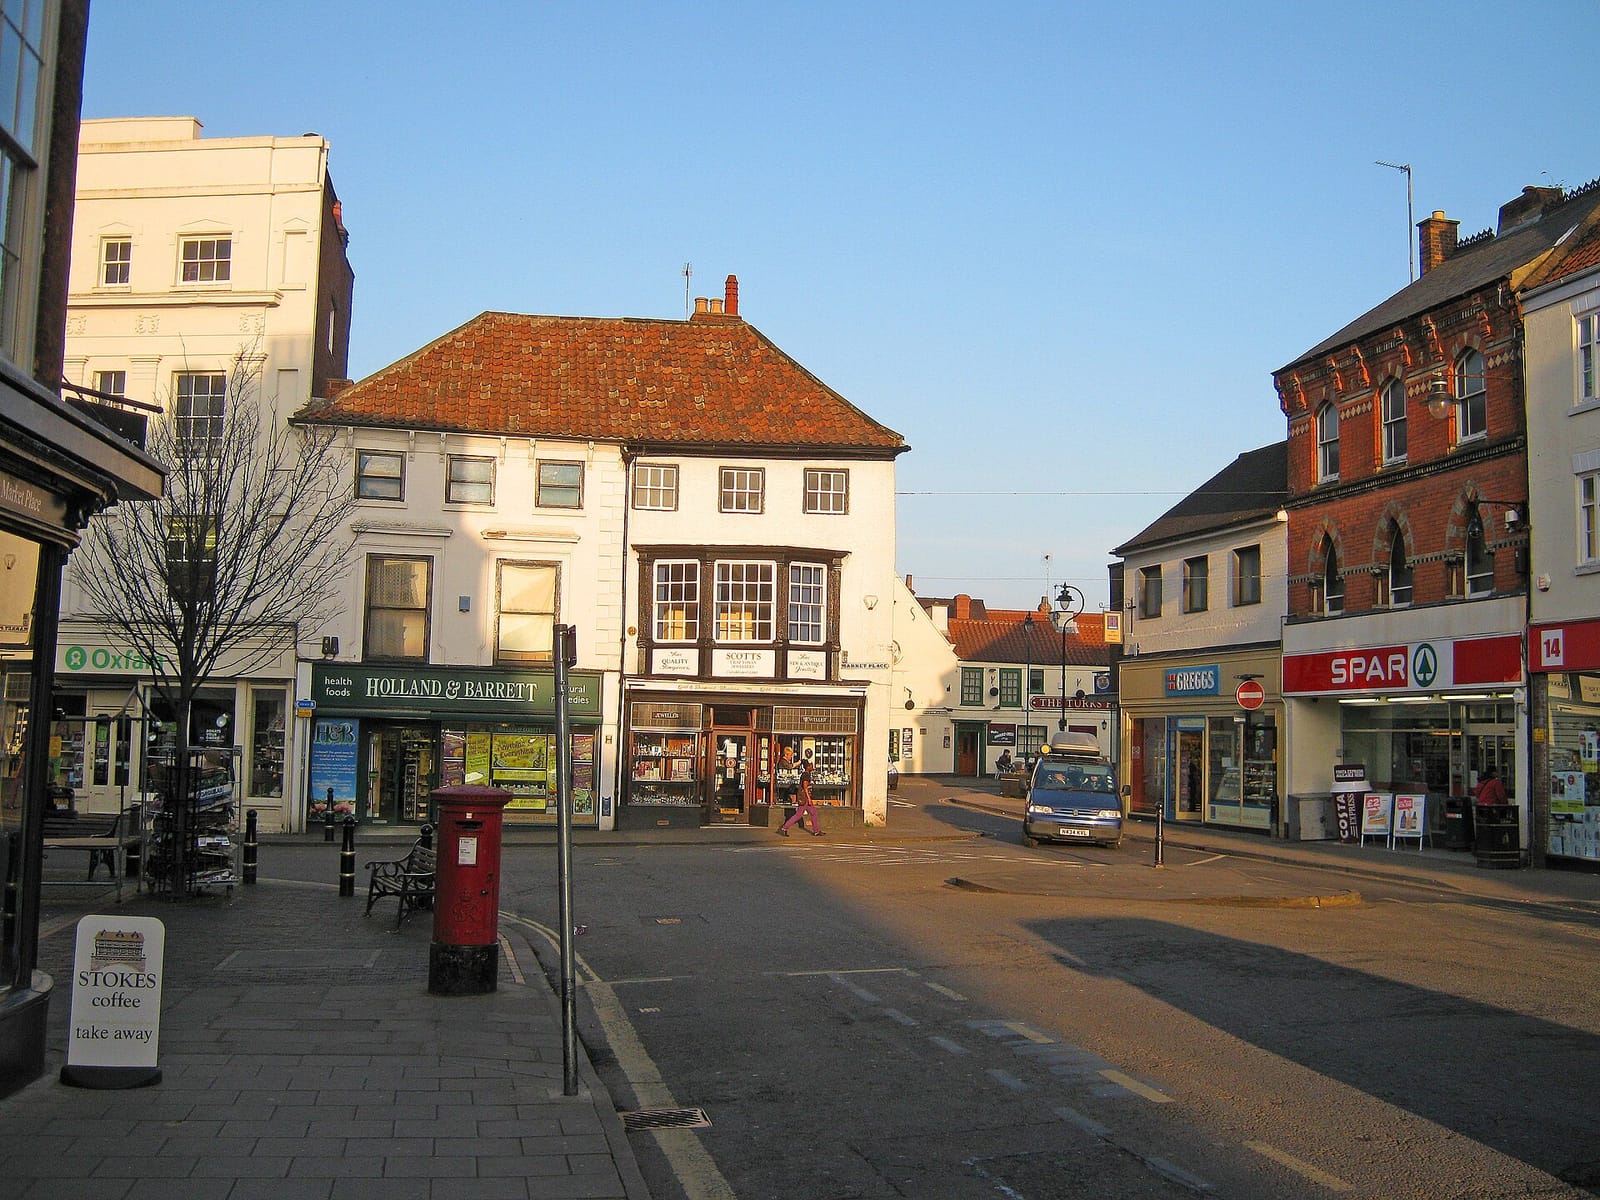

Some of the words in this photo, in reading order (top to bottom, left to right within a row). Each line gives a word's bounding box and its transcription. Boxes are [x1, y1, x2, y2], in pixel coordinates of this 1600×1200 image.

[1, 480, 25, 505] Market
[24, 490, 41, 512] Place
[726, 652, 762, 661] SCOTTS
[1543, 638, 1561, 658] 14
[1331, 653, 1405, 684] SPAR
[324, 676, 352, 686] health
[366, 677, 442, 697] HOLLAND
[445, 679, 461, 700] &
[465, 681, 538, 702] BARRETT
[1176, 670, 1215, 691] GREGGS
[326, 688, 351, 697] foods
[1040, 698, 1063, 708] THE
[1067, 699, 1102, 708] TURKS
[312, 722, 357, 745] H&B
[1346, 793, 1357, 826] EXPRESS
[1366, 798, 1380, 808] £2
[1336, 794, 1348, 839] COSTA
[78, 970, 157, 989] STOKES
[91, 991, 141, 1008] coffee
[75, 1025, 109, 1040] take
[114, 1028, 153, 1044] away
